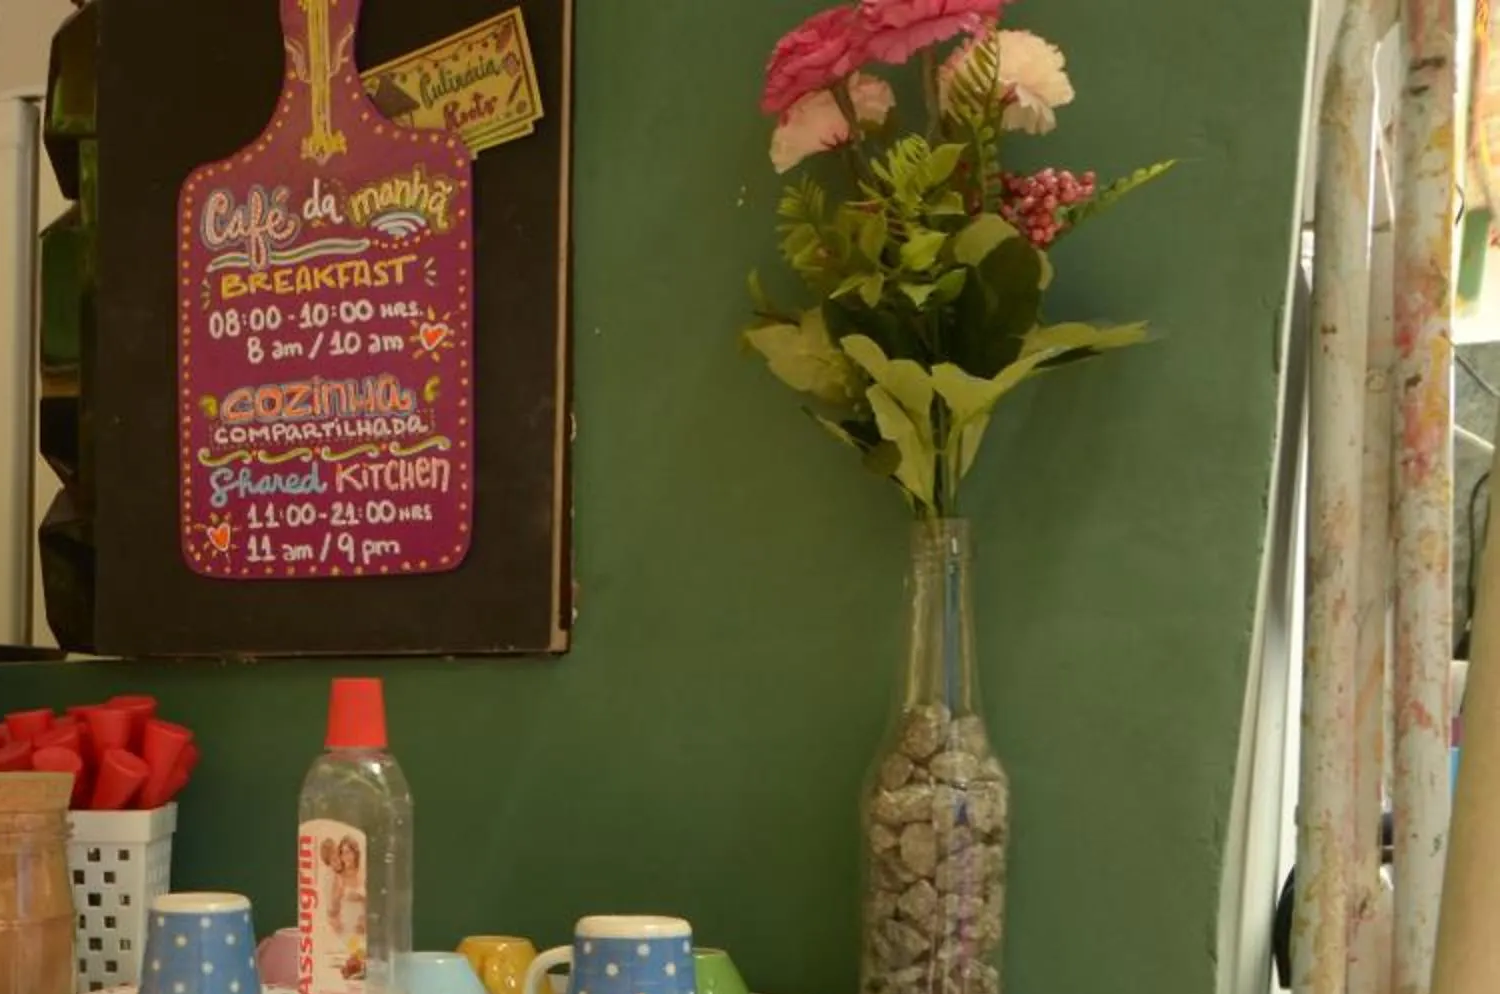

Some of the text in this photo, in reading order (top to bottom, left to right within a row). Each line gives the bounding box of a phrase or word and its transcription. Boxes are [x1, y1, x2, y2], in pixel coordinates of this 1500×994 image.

[203, 168, 453, 270] Café da manhã
[220, 254, 418, 300] BREAKFAST
[208, 304, 282, 339] 08:00
[300, 299, 374, 328] 10:00
[247, 335, 264, 364] 8
[272, 339, 304, 360] am
[329, 331, 362, 356] 10
[368, 333, 405, 352] am
[209, 462, 329, 508] Shared
[247, 535, 276, 563] 11
[282, 542, 314, 561] am
[337, 533, 355, 563] 9
[361, 539, 401, 565] pm
